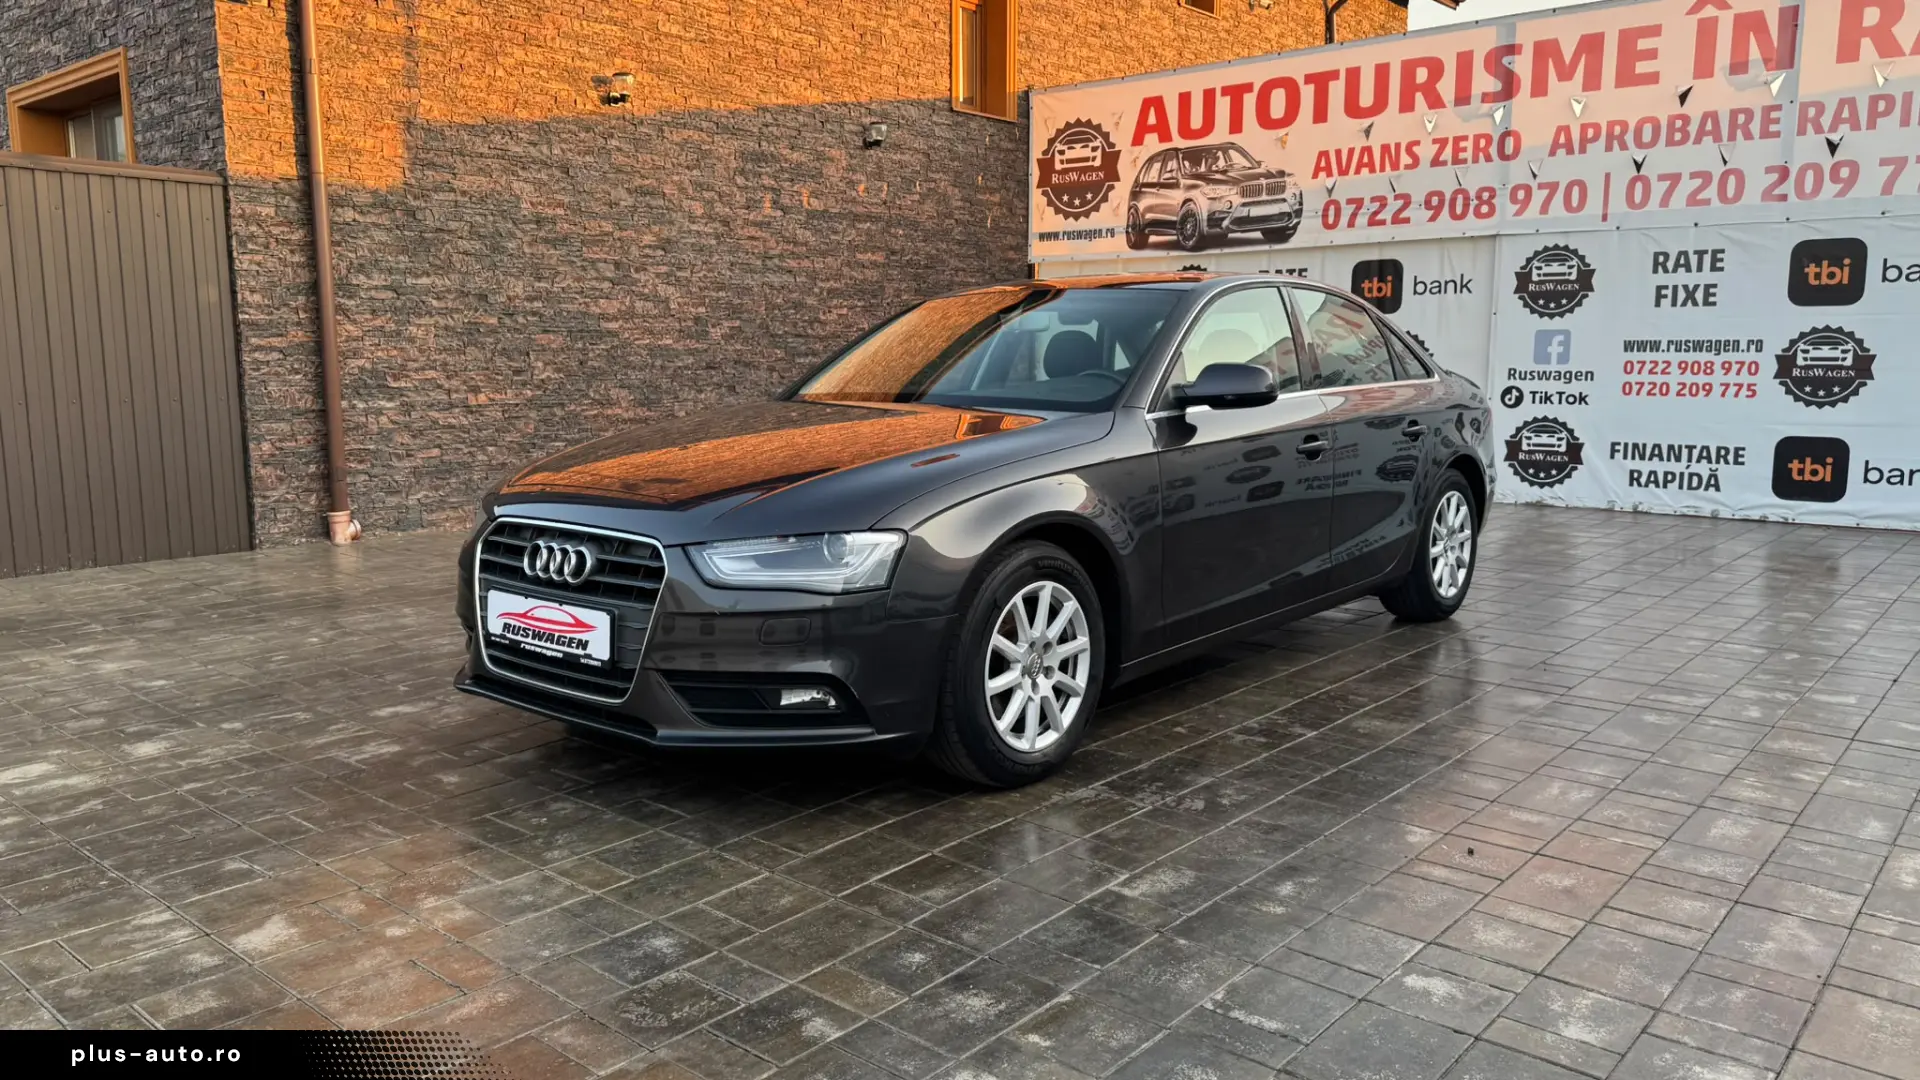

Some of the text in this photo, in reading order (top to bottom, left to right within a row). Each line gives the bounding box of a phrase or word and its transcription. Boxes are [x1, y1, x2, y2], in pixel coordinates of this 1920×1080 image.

[1131, 0, 1920, 147] AUTOTURISME ÎN R
[1311, 90, 1920, 179] AVANS ZERO APROBARE RAPI
[1321, 192, 1412, 231] 0722
[1423, 186, 1497, 223] 908
[1508, 179, 1589, 217] 970
[1625, 167, 1746, 211] 0720
[1760, 158, 1861, 202] 209
[1878, 154, 1920, 197] 7
[1038, 227, 1116, 243] www.ruswagen.ro
[1651, 248, 1726, 275] RATE
[1804, 257, 1920, 286] tbi ba
[1361, 273, 1473, 298] tbi bank
[1654, 283, 1719, 308] FIXE
[1623, 338, 1764, 356] www.ruswagen.ro
[1507, 367, 1595, 385] Ruswagen
[1623, 359, 1760, 377] 0722 908 970
[1529, 390, 1590, 406] TikTok
[1621, 380, 1758, 399] 0720 209 775
[1787, 456, 1920, 487] tbi ban
[501, 621, 590, 652] RUSWAGEN
